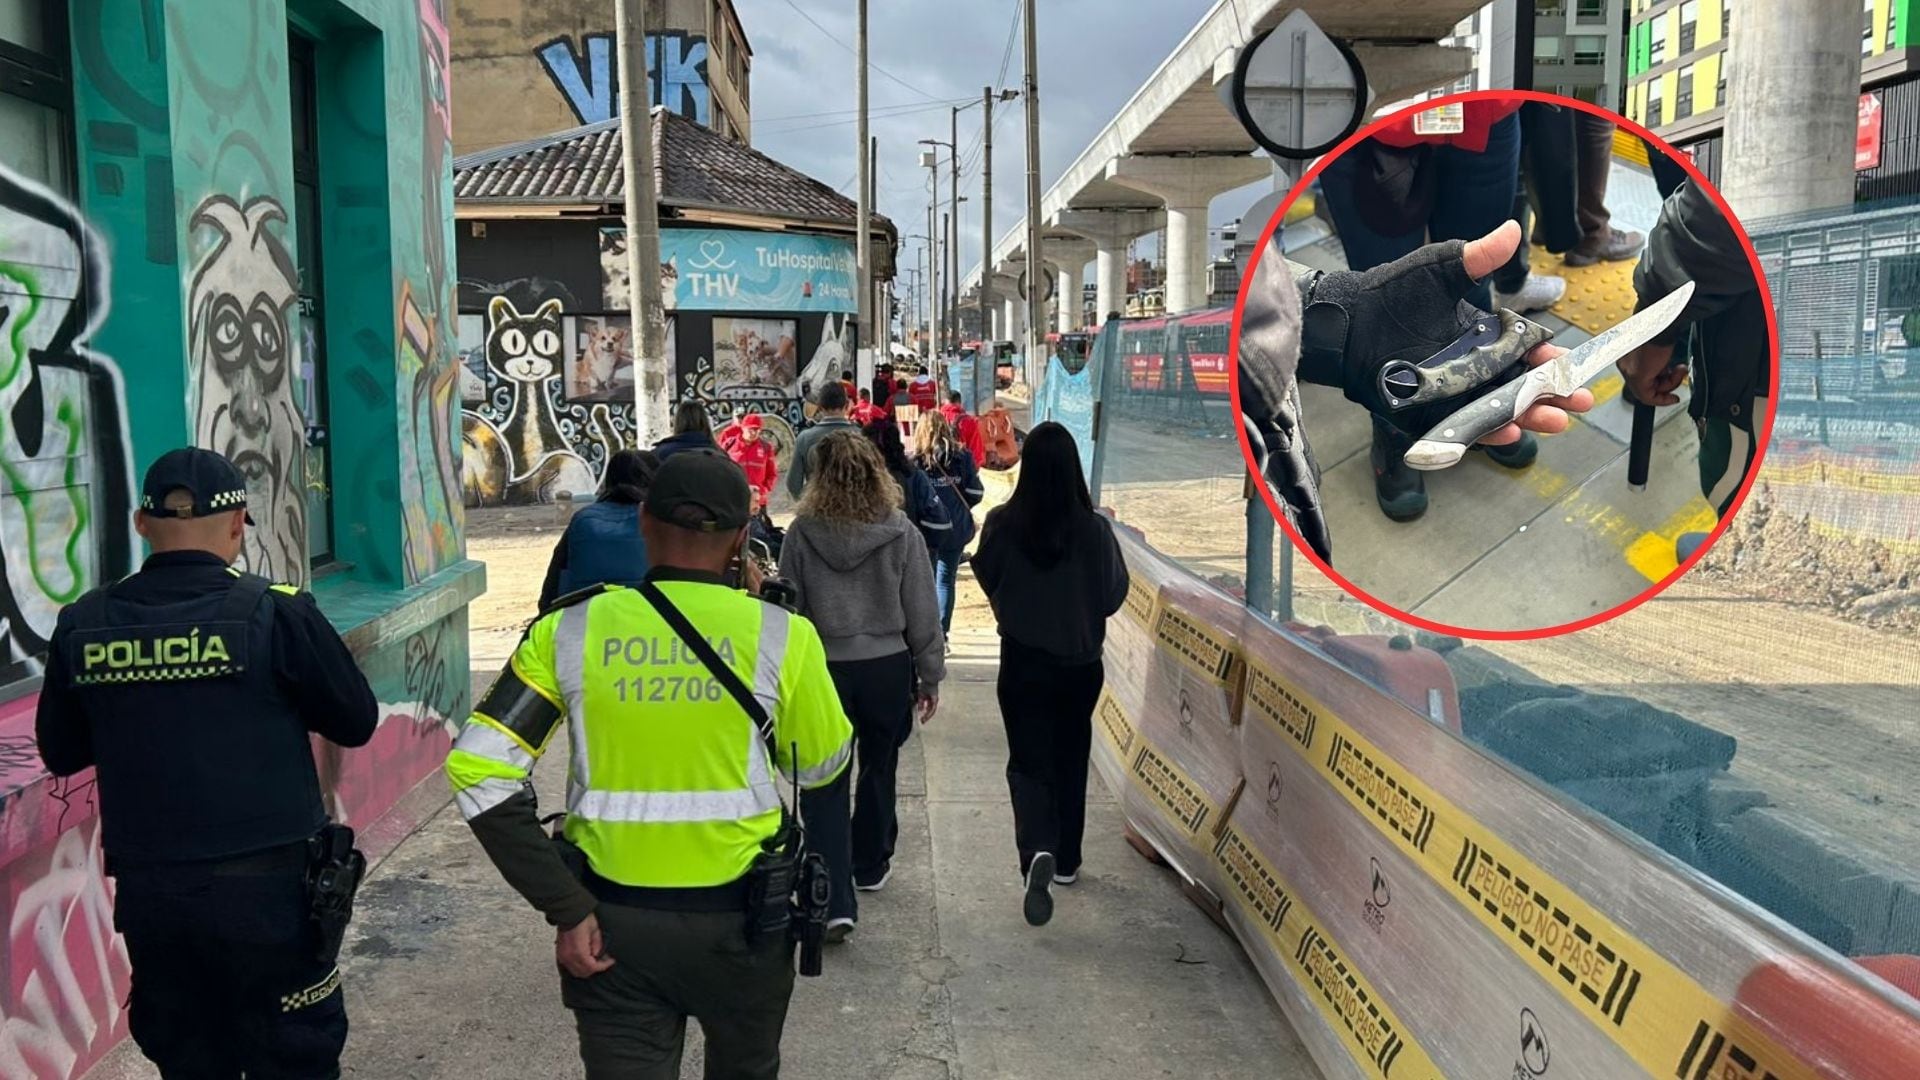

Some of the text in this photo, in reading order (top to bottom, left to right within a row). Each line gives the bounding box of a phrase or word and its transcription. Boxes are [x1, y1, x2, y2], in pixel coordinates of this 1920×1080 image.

[685, 273, 740, 297] THV
[818, 282, 830, 297] 24
[83, 626, 231, 670] POLICÍA
[603, 636, 737, 667] POLICA
[613, 676, 722, 702] 112706
[1176, 792, 1199, 817] PASE
[1340, 749, 1418, 829] PELIGRO NO PASE
[1258, 882, 1278, 913] PASE
[1474, 863, 1606, 986] PELIGRO NO PASE
[1310, 947, 1382, 1050] PELIGRO NO PASE
